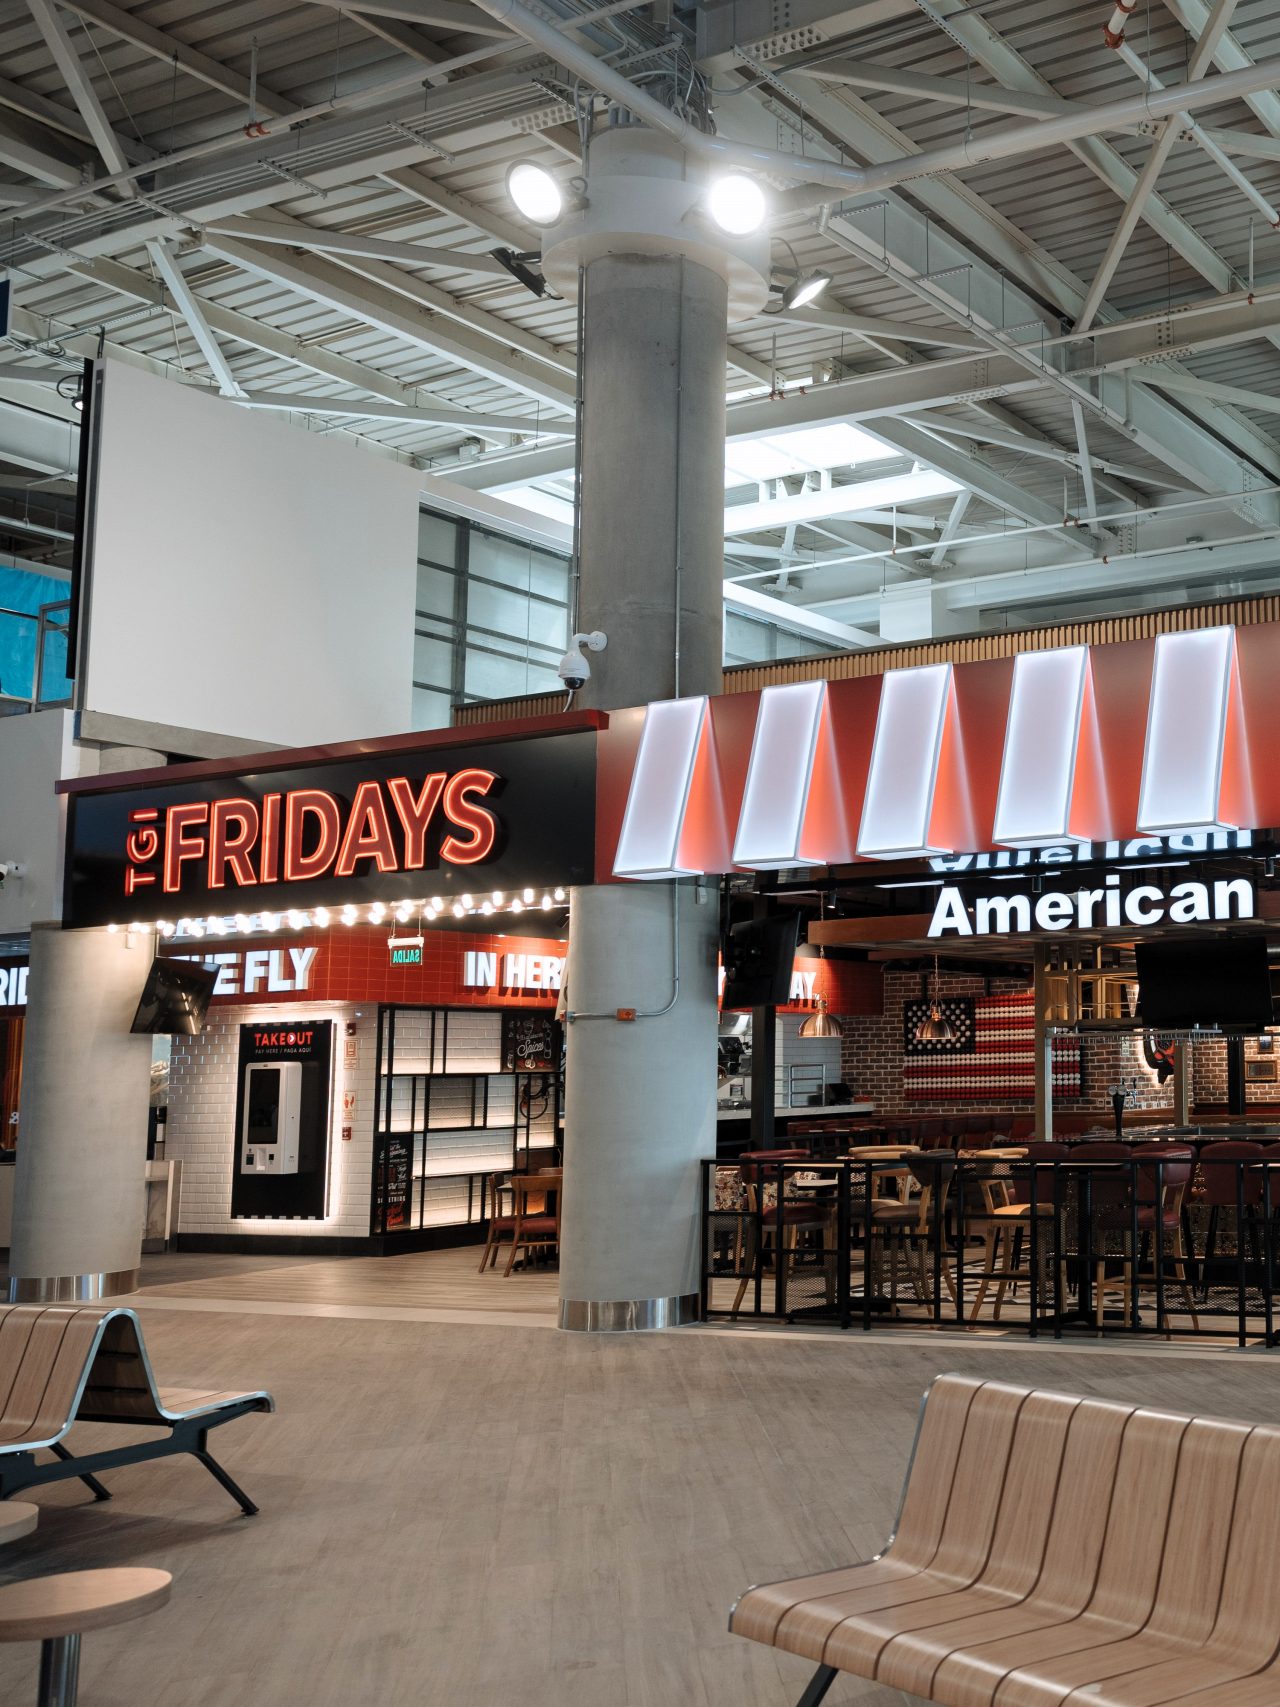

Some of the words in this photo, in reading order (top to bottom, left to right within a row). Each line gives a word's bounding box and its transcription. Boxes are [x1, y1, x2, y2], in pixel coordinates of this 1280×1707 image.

[125, 808, 159, 896] TGI
[163, 768, 497, 893] FRIDAYS
[927, 874, 1254, 937] American
[244, 947, 318, 993] FLY
[463, 951, 497, 987] IN
[503, 953, 567, 990] HER
[255, 1031, 313, 1047] TAKEOUT
